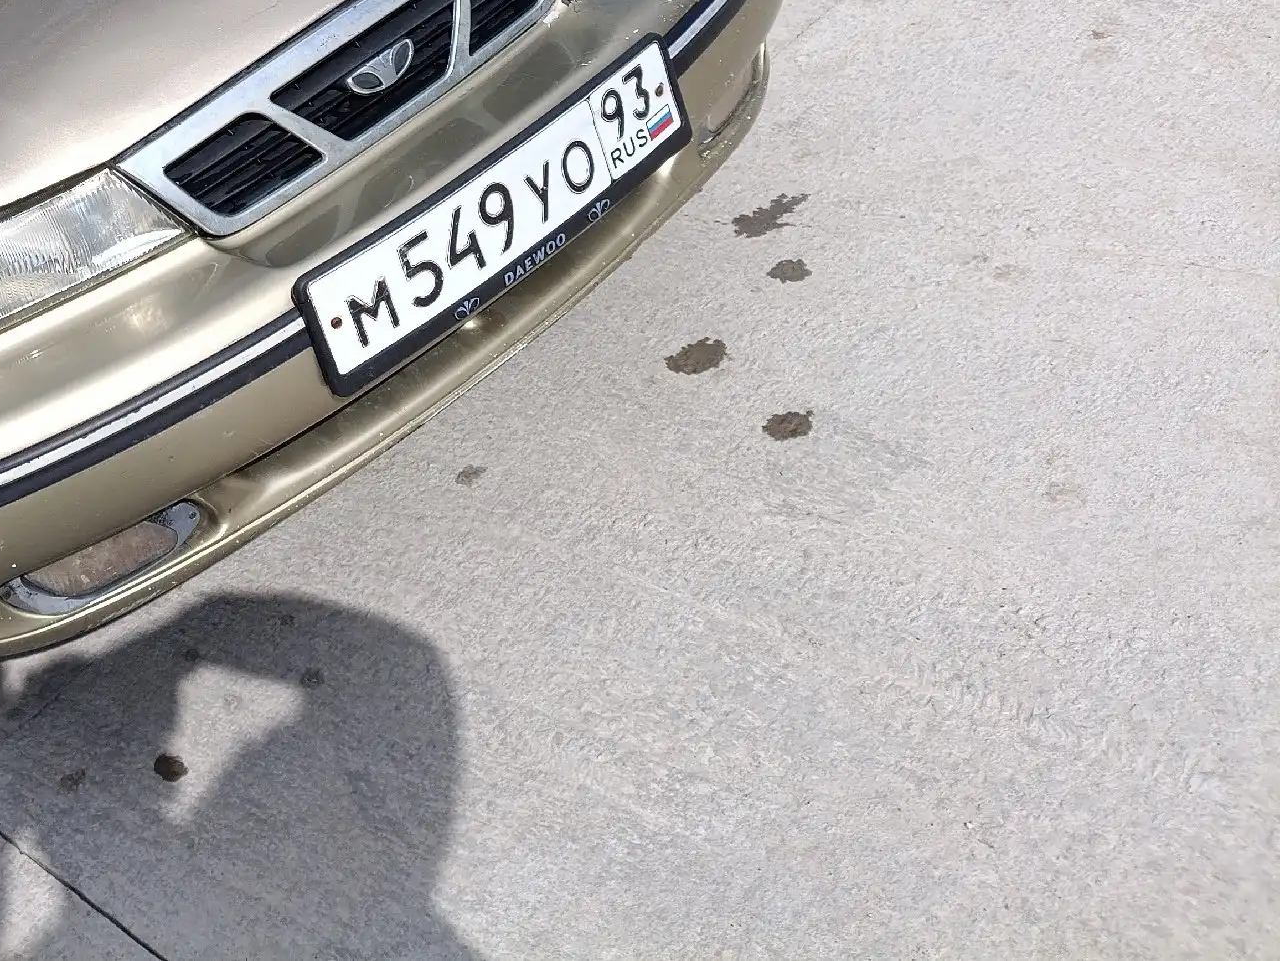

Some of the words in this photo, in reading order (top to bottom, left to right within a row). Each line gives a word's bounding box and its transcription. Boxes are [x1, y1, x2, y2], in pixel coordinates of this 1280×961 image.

[601, 64, 650, 141] 93
[611, 129, 648, 168] RUS
[503, 233, 566, 287] DAEWOO
